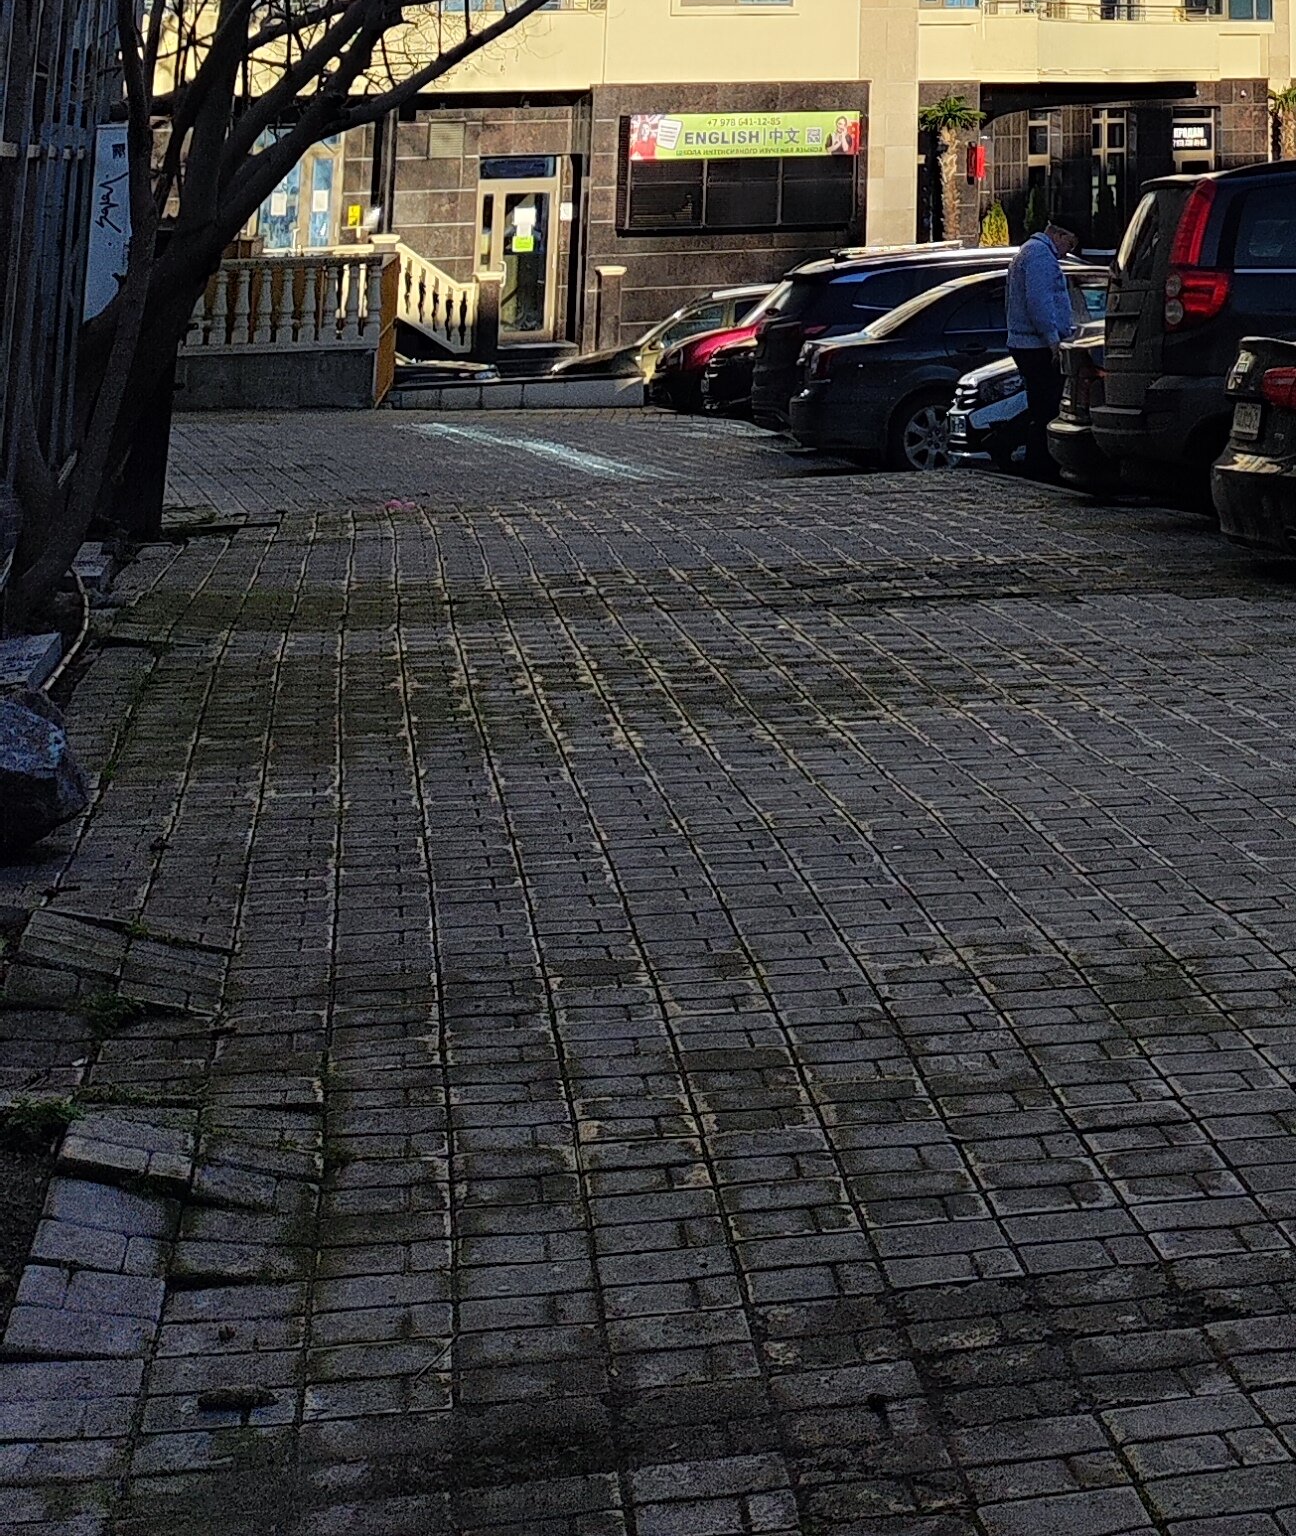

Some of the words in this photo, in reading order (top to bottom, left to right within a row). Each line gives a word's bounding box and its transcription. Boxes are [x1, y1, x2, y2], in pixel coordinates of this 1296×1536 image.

[720, 117, 736, 127] 978
[684, 130, 760, 145] ENGLISH
[769, 127, 801, 145] 中文
